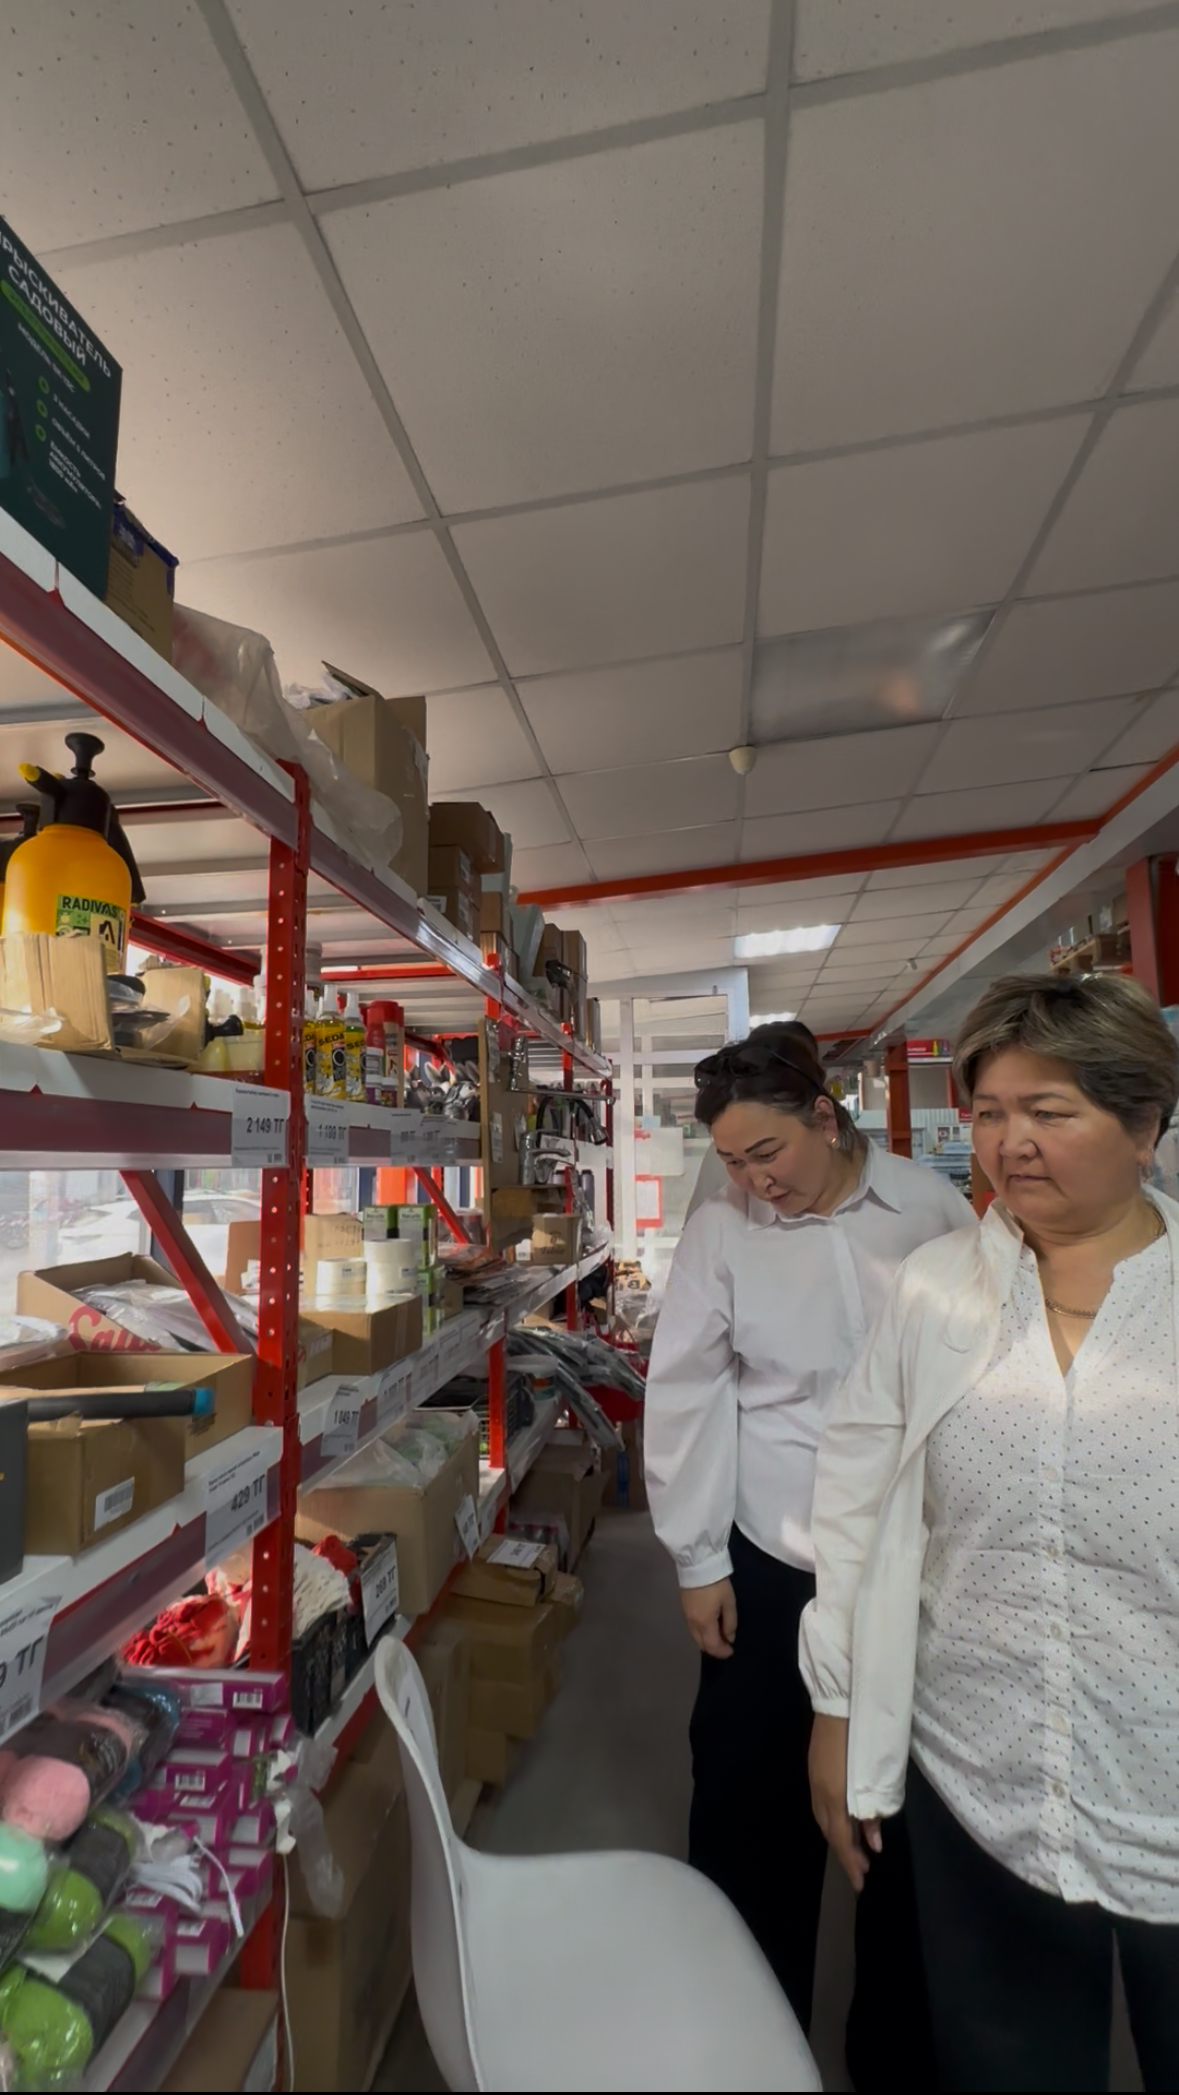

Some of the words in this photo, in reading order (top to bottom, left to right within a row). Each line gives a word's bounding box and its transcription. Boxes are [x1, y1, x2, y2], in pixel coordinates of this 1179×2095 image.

[8, 265, 86, 367] САДОВЫЙ
[62, 896, 118, 919] RADIVAS
[246, 1117, 252, 1133] 2
[256, 1117, 272, 1133] 149
[274, 1118, 285, 1133] ТГ
[231, 1485, 250, 1512] 429
[252, 1473, 265, 1497] ТГ
[15, 1634, 45, 1676] ТГ
